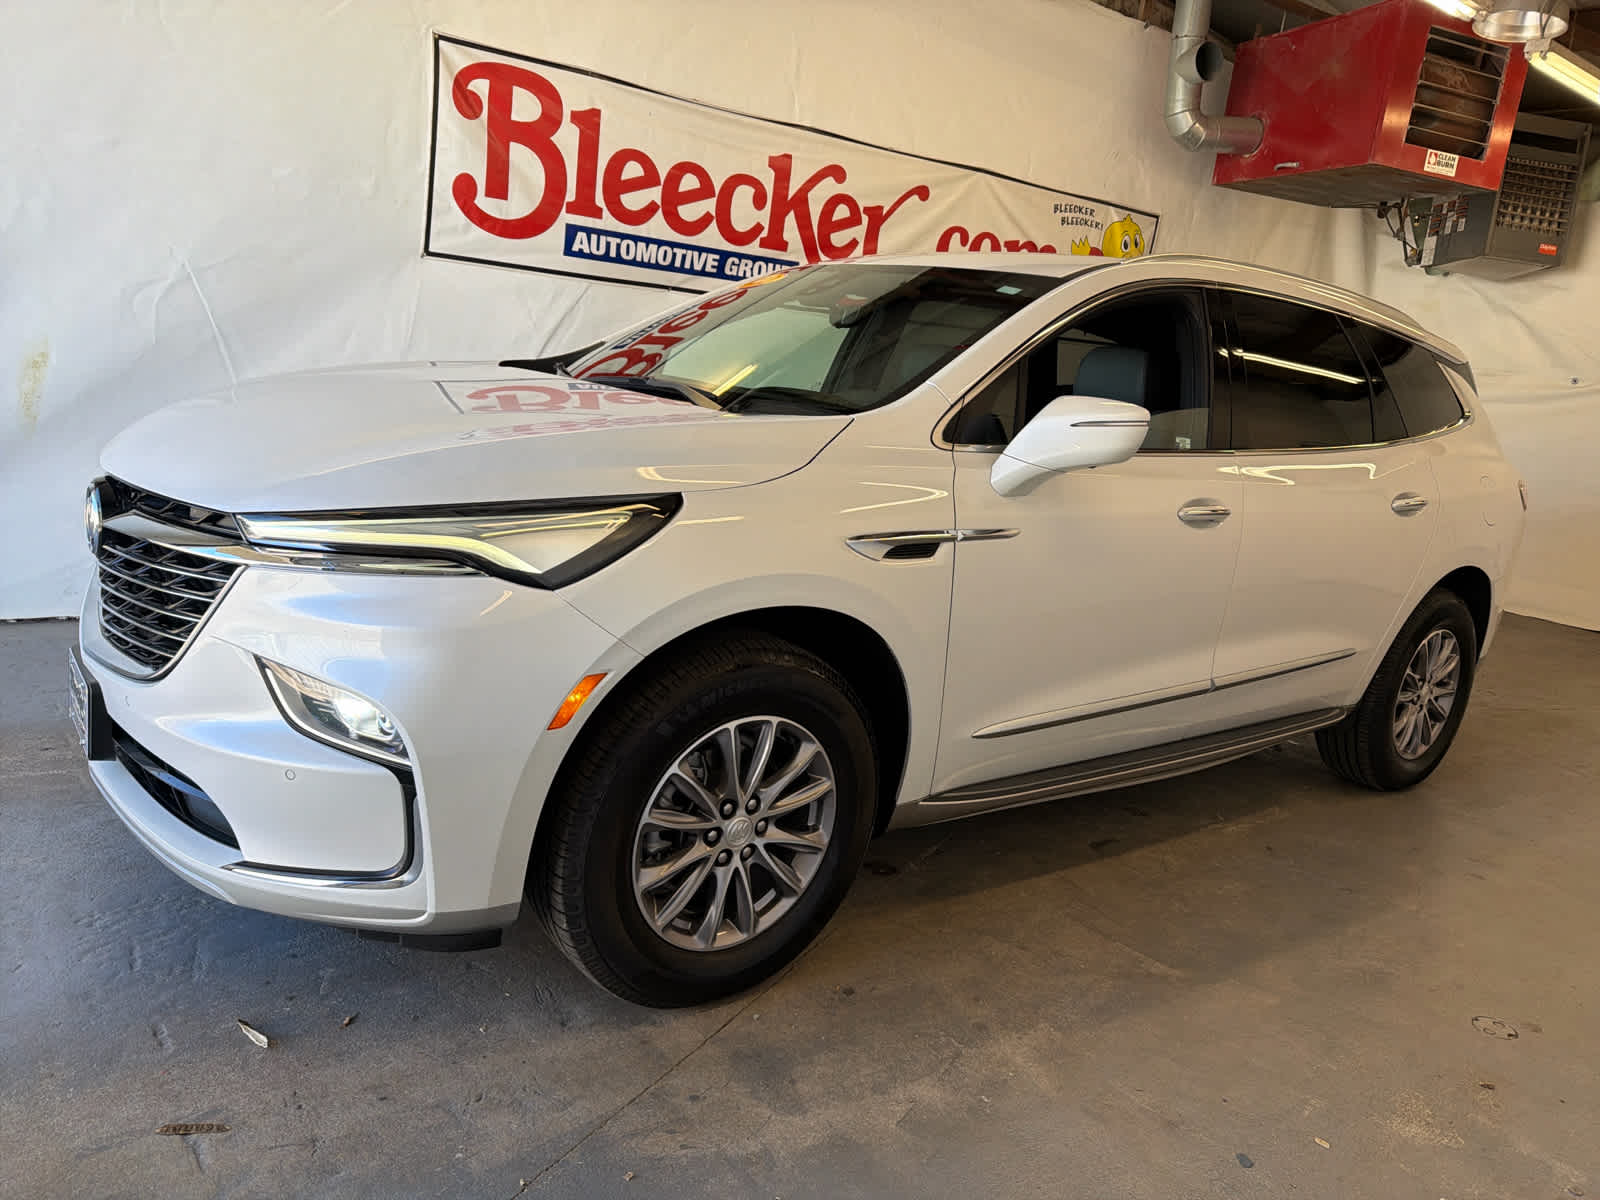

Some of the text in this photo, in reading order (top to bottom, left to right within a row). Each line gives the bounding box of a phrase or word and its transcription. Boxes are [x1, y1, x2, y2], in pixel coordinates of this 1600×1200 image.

[452, 61, 930, 264] Bleecker
[1437, 160, 1455, 169] BURN
[1438, 153, 1457, 162] CLEAN
[571, 231, 793, 278] AUTOMOTIVE GROU
